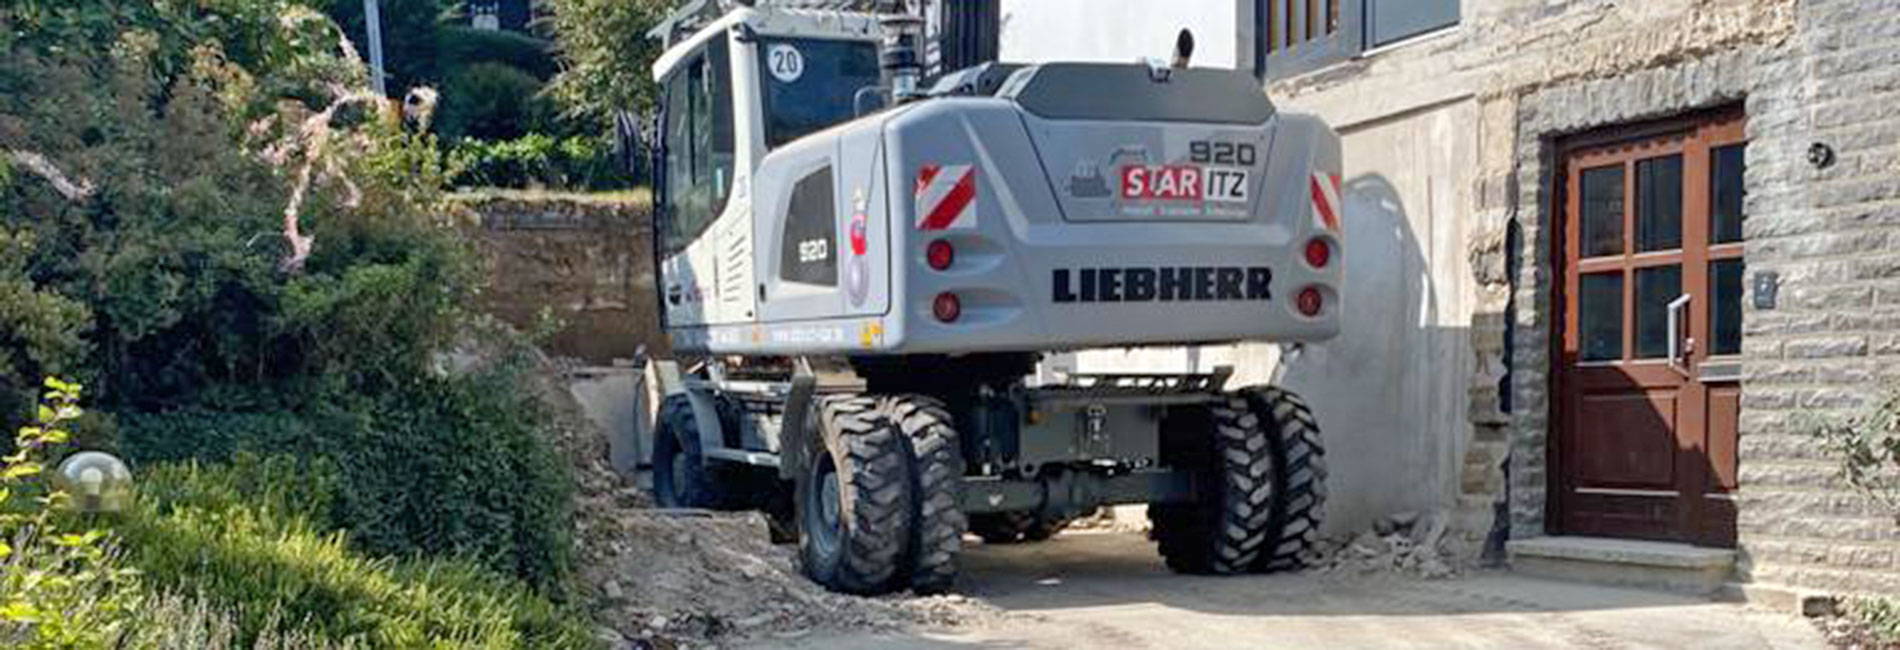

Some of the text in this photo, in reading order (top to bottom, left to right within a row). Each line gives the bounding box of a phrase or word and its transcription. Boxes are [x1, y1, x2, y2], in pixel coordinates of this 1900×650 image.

[774, 51, 797, 73] 20
[1189, 141, 1256, 166] 920
[799, 238, 828, 262] 920
[1052, 267, 1272, 302] LIEBHERR
